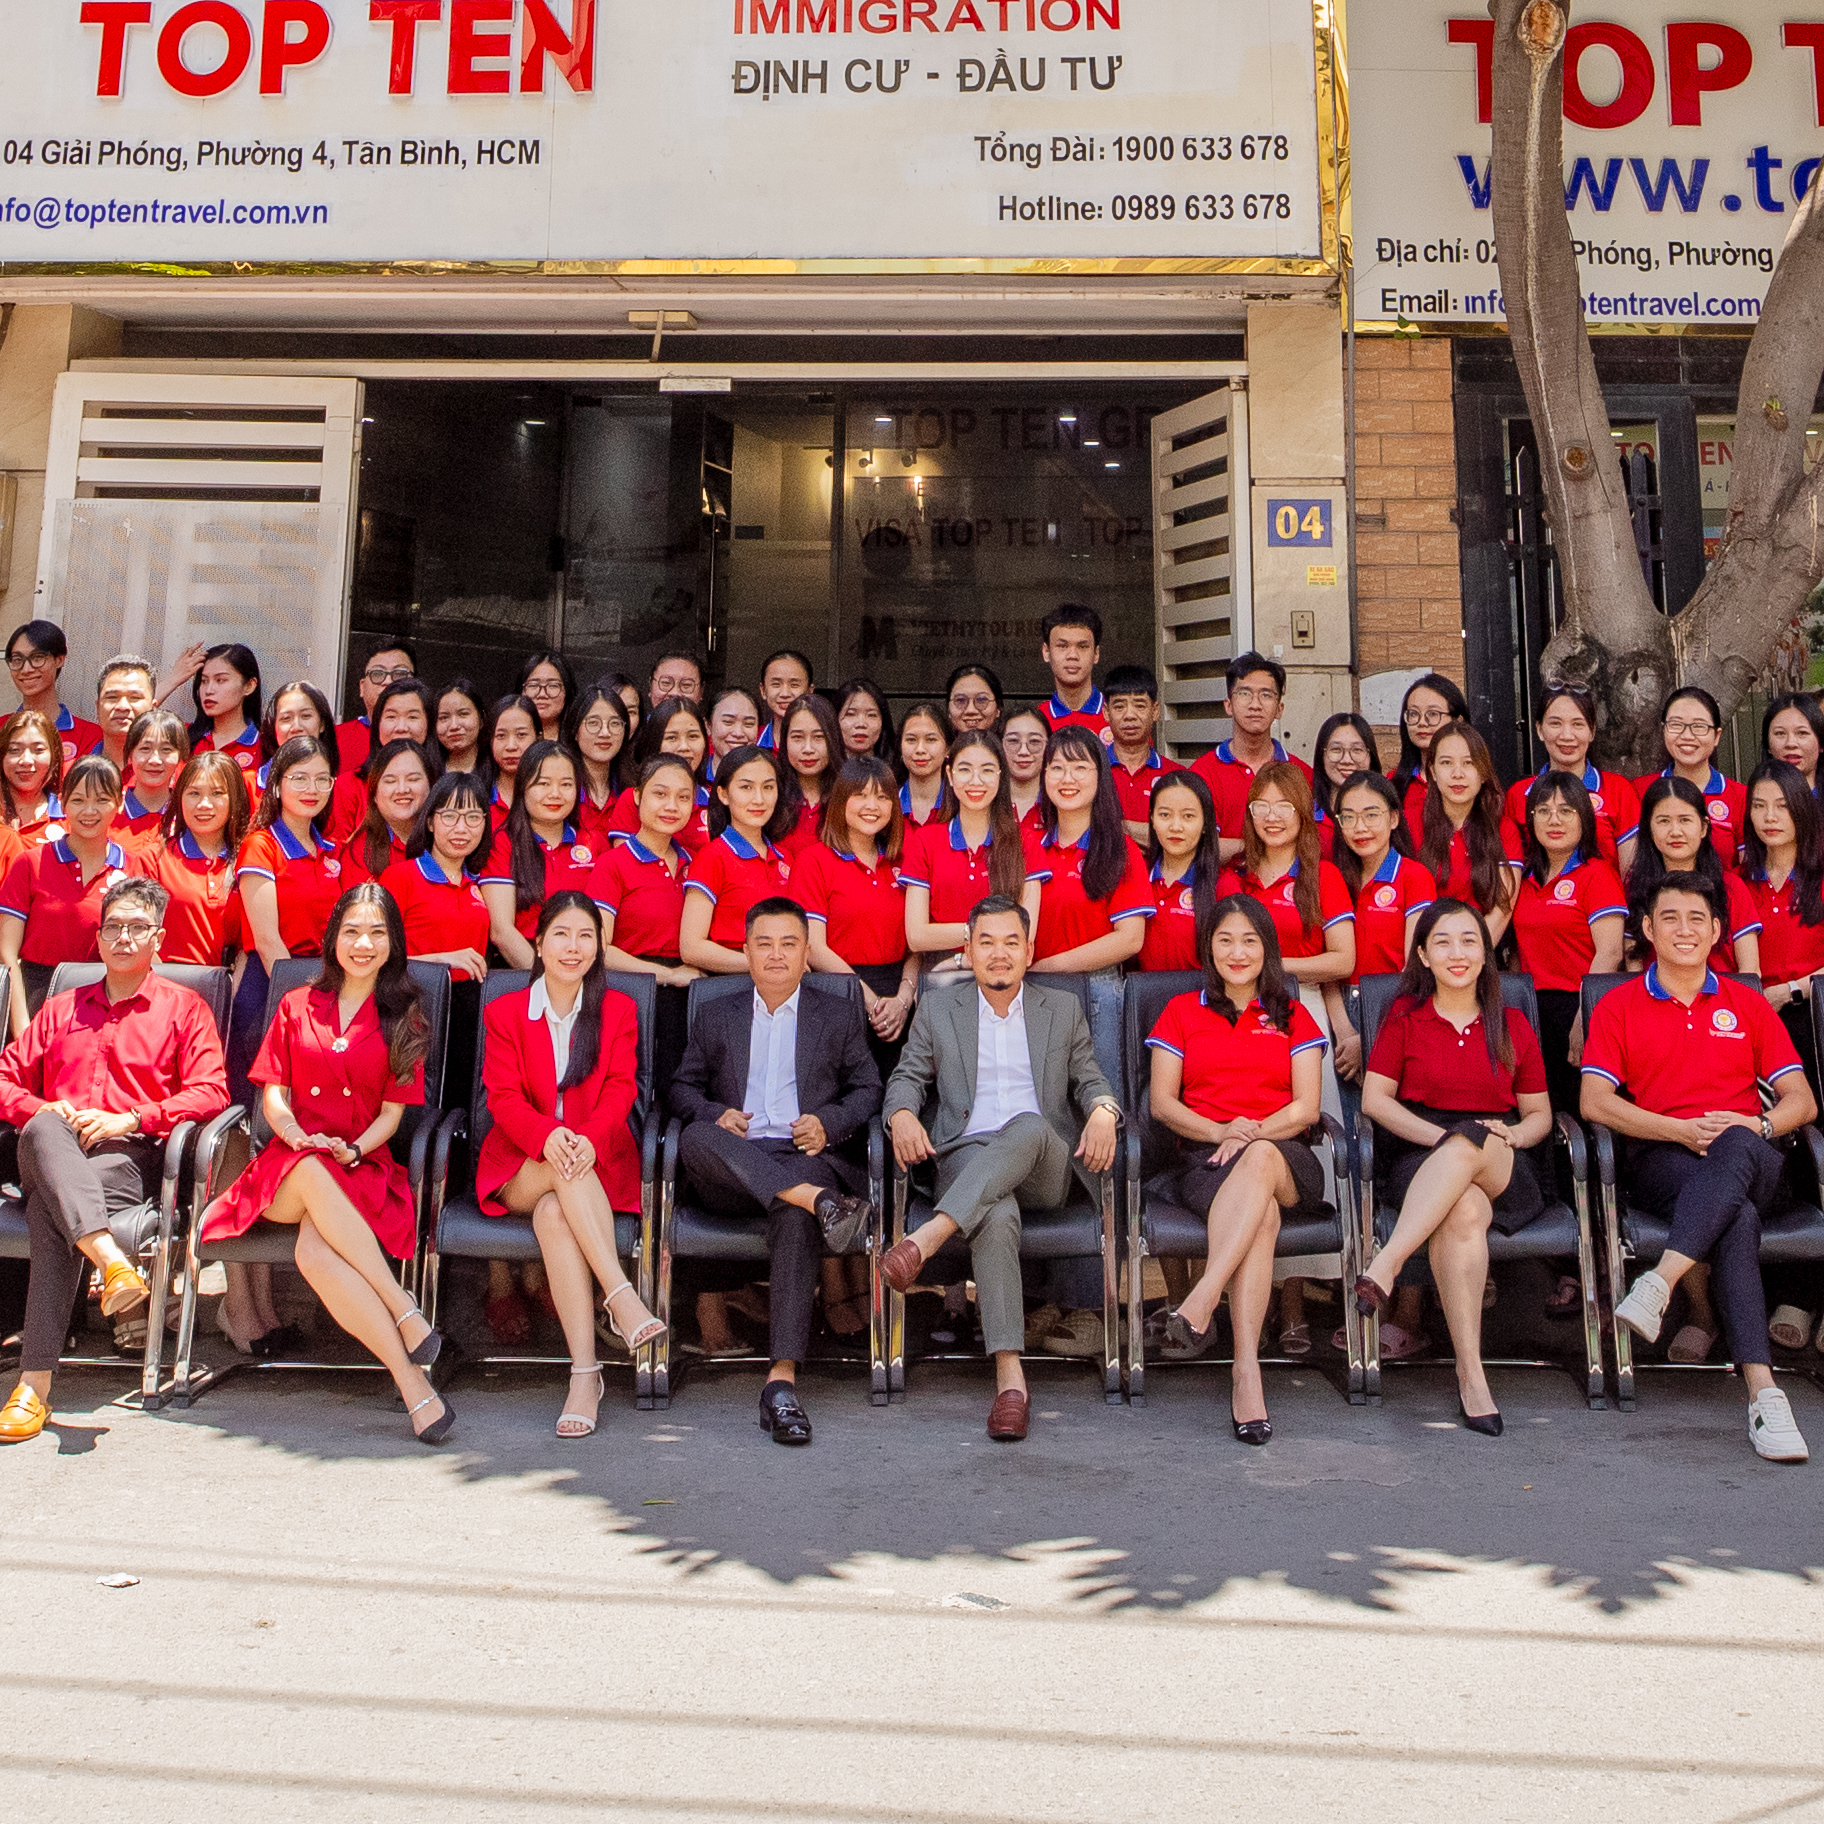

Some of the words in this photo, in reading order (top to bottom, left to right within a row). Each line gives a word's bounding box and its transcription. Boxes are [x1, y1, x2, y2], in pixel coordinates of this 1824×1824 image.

[732, 59, 828, 101] ĐỊNH
[844, 57, 909, 94] CƯ
[957, 47, 1046, 94] ĐẦU
[1060, 54, 1122, 92] TƯ
[2, 139, 33, 166] 04
[41, 138, 91, 166] Giải
[98, 139, 189, 172] Phóng,
[196, 139, 304, 171] Phường
[341, 139, 392, 167] Tân
[399, 139, 468, 171] Bình,
[475, 138, 541, 166] HCM
[974, 131, 1042, 169] Tổng
[1112, 135, 1175, 162] 1900
[1181, 135, 1233, 162] 633
[1239, 134, 1290, 161] 678
[998, 194, 1103, 222] Hotline:
[1111, 194, 1176, 221] 0989
[1184, 194, 1235, 221] 633
[1242, 193, 1291, 220] 678
[1376, 237, 1418, 266] Địa
[1668, 239, 1774, 273] Phường
[1275, 505, 1325, 540] 04
